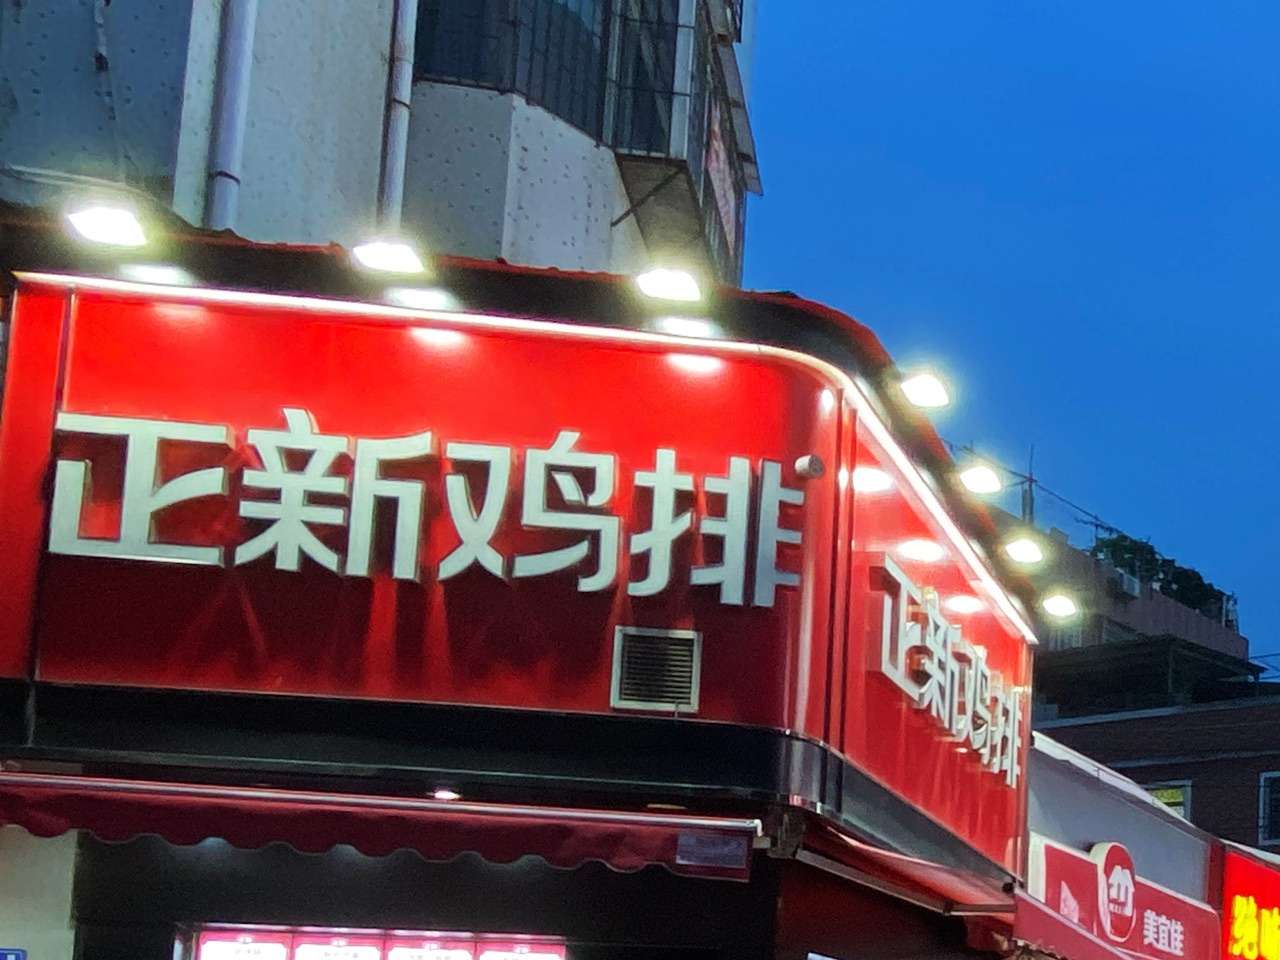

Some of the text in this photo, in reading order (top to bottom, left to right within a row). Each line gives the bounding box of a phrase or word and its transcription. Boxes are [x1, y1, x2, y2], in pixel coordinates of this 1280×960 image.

[49, 408, 806, 608] 正新鸡排
[1143, 908, 1184, 957] 美宜佳
